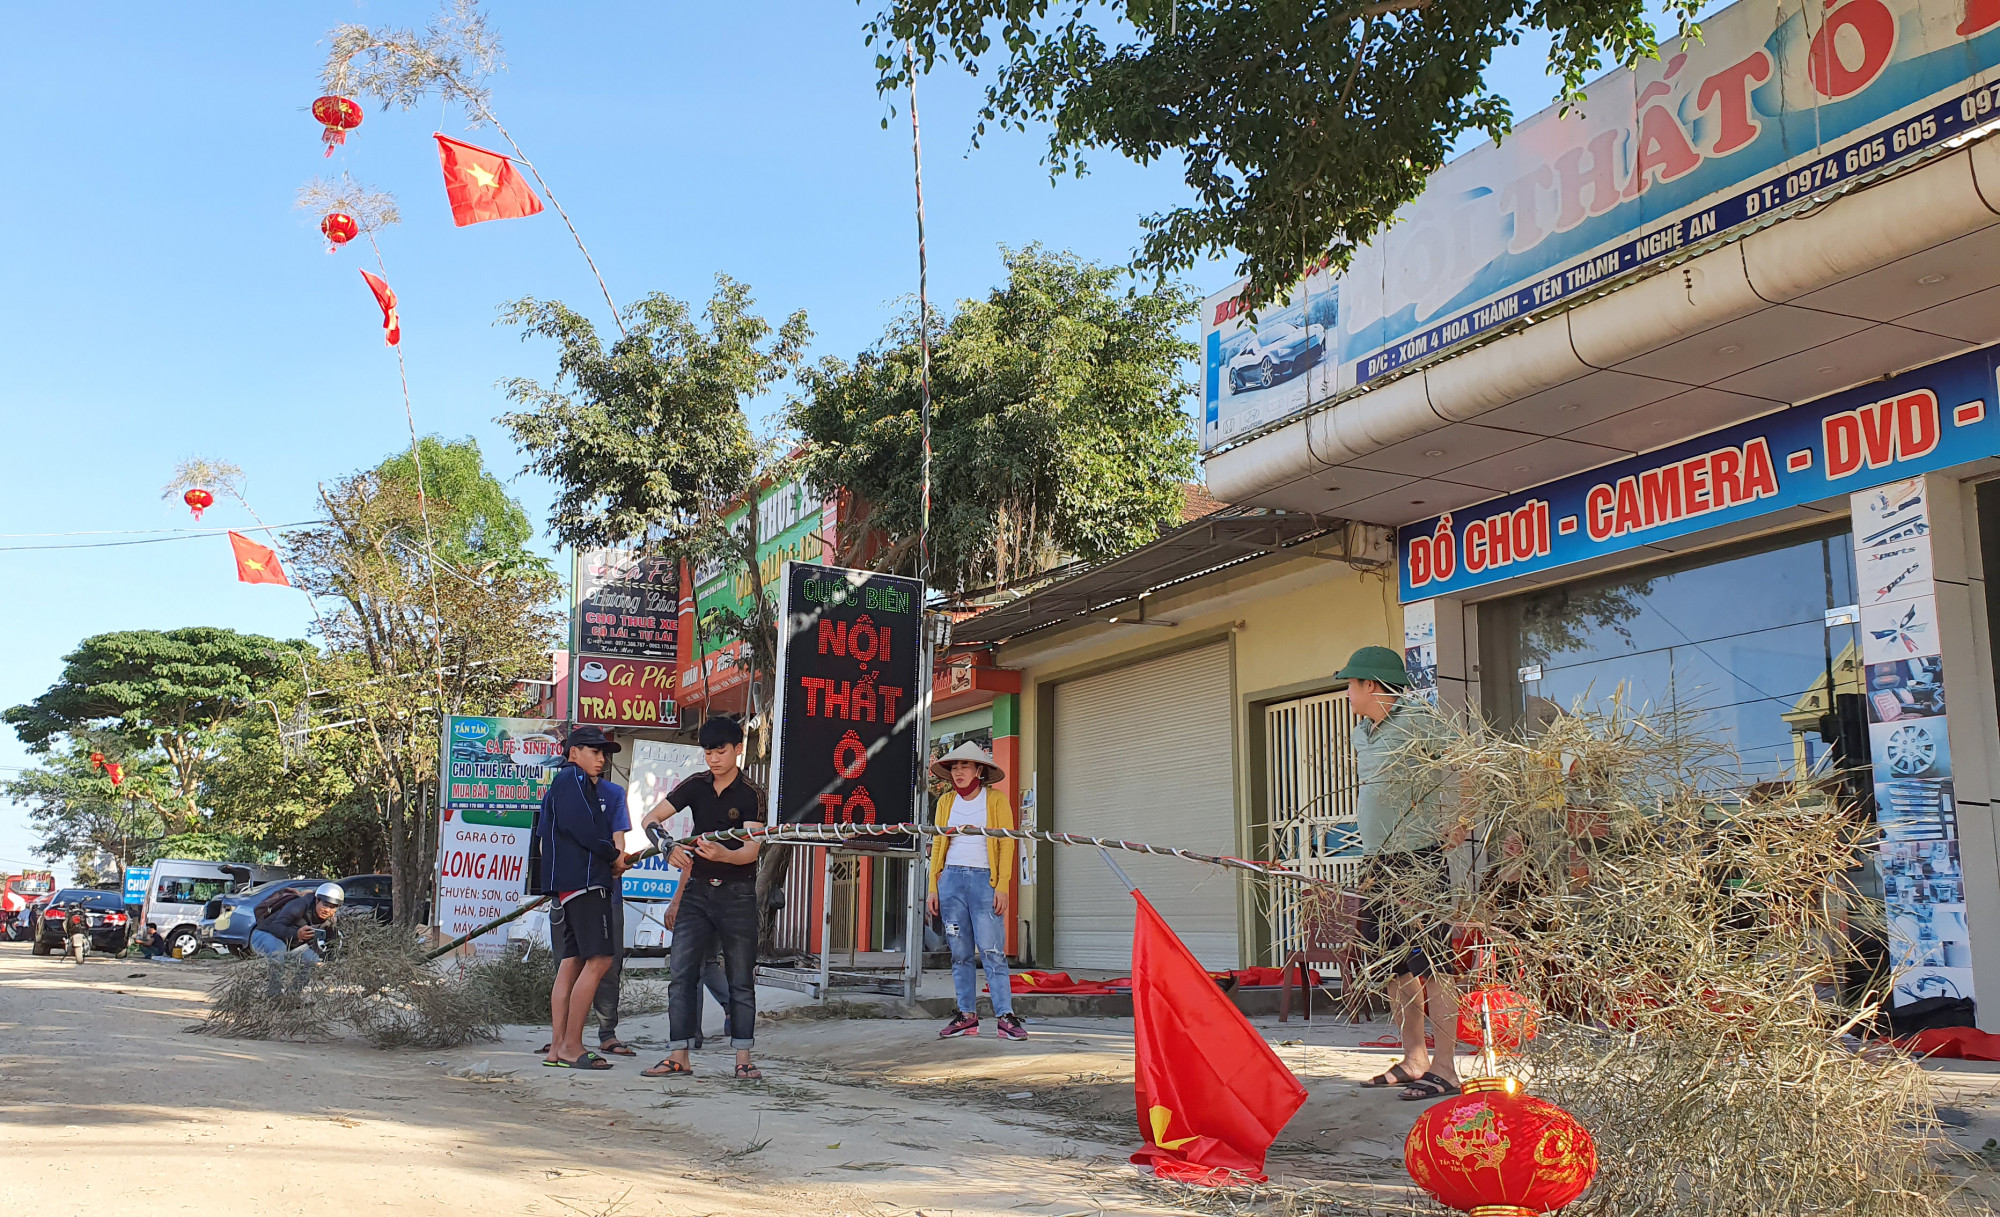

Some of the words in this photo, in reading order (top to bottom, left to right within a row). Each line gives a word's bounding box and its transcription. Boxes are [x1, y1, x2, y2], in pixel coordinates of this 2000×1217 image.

[1500, 52, 1771, 253] THẤT
[1399, 336, 1428, 364] XÓM
[1430, 332, 1439, 349] 4
[1442, 322, 1470, 347] HOA
[1472, 295, 1519, 330] THÀNH
[1532, 279, 1562, 306] YÊN
[1566, 252, 1620, 289] THÀNH
[1636, 223, 1684, 262] NGHỆ
[1689, 211, 1717, 240] AN
[1746, 187, 1781, 217] ĐT:
[1786, 162, 1839, 199] 0974
[1845, 137, 1886, 172] 605
[1892, 114, 1937, 153] 605
[1410, 513, 1456, 586] ĐỒ
[1464, 499, 1551, 572] CHƠI
[1586, 436, 1779, 542] CAMERA
[1823, 388, 1940, 481] DVD
[1867, 547, 1916, 561] Sports
[803, 575, 858, 606] QUỐC
[866, 586, 909, 614] BIÊN
[1875, 562, 1919, 602] Sports
[586, 612, 616, 625] CHO
[620, 615, 656, 629] THUÊ
[660, 619, 678, 630] XE
[592, 624, 607, 636] CÓ
[610, 627, 628, 638] LÁI
[656, 631, 673, 642] LÁI
[818, 614, 891, 670] NỘI
[609, 664, 635, 687] Cà
[580, 691, 617, 720] TRÀ
[622, 694, 656, 721] SỮA
[801, 670, 903, 724] THẤT
[486, 736, 500, 753] CÀ
[503, 737, 516, 754] FÊ
[523, 741, 547, 755] SINH
[833, 729, 867, 779] Ô
[452, 762, 472, 778] CHO
[474, 761, 498, 778] THUÊ
[500, 763, 512, 778] XE
[515, 764, 529, 782] TỰ
[529, 763, 544, 779] LÁI
[452, 784, 470, 798] MUA
[472, 781, 489, 798] BÁN
[496, 785, 516, 799] TRAO
[819, 785, 876, 825] TÔ
[456, 830, 487, 843] GARA
[490, 832, 499, 843] Ô
[501, 833, 516, 845] TÔ
[441, 850, 487, 879] LONG
[487, 854, 523, 881] ANH
[440, 886, 480, 899] CHUYÊN:
[481, 889, 503, 902] SƠN,
[622, 881, 639, 891] ĐT
[642, 881, 671, 893] 0948
[454, 903, 477, 918] HÀN,
[479, 905, 501, 920] ĐIỆN
